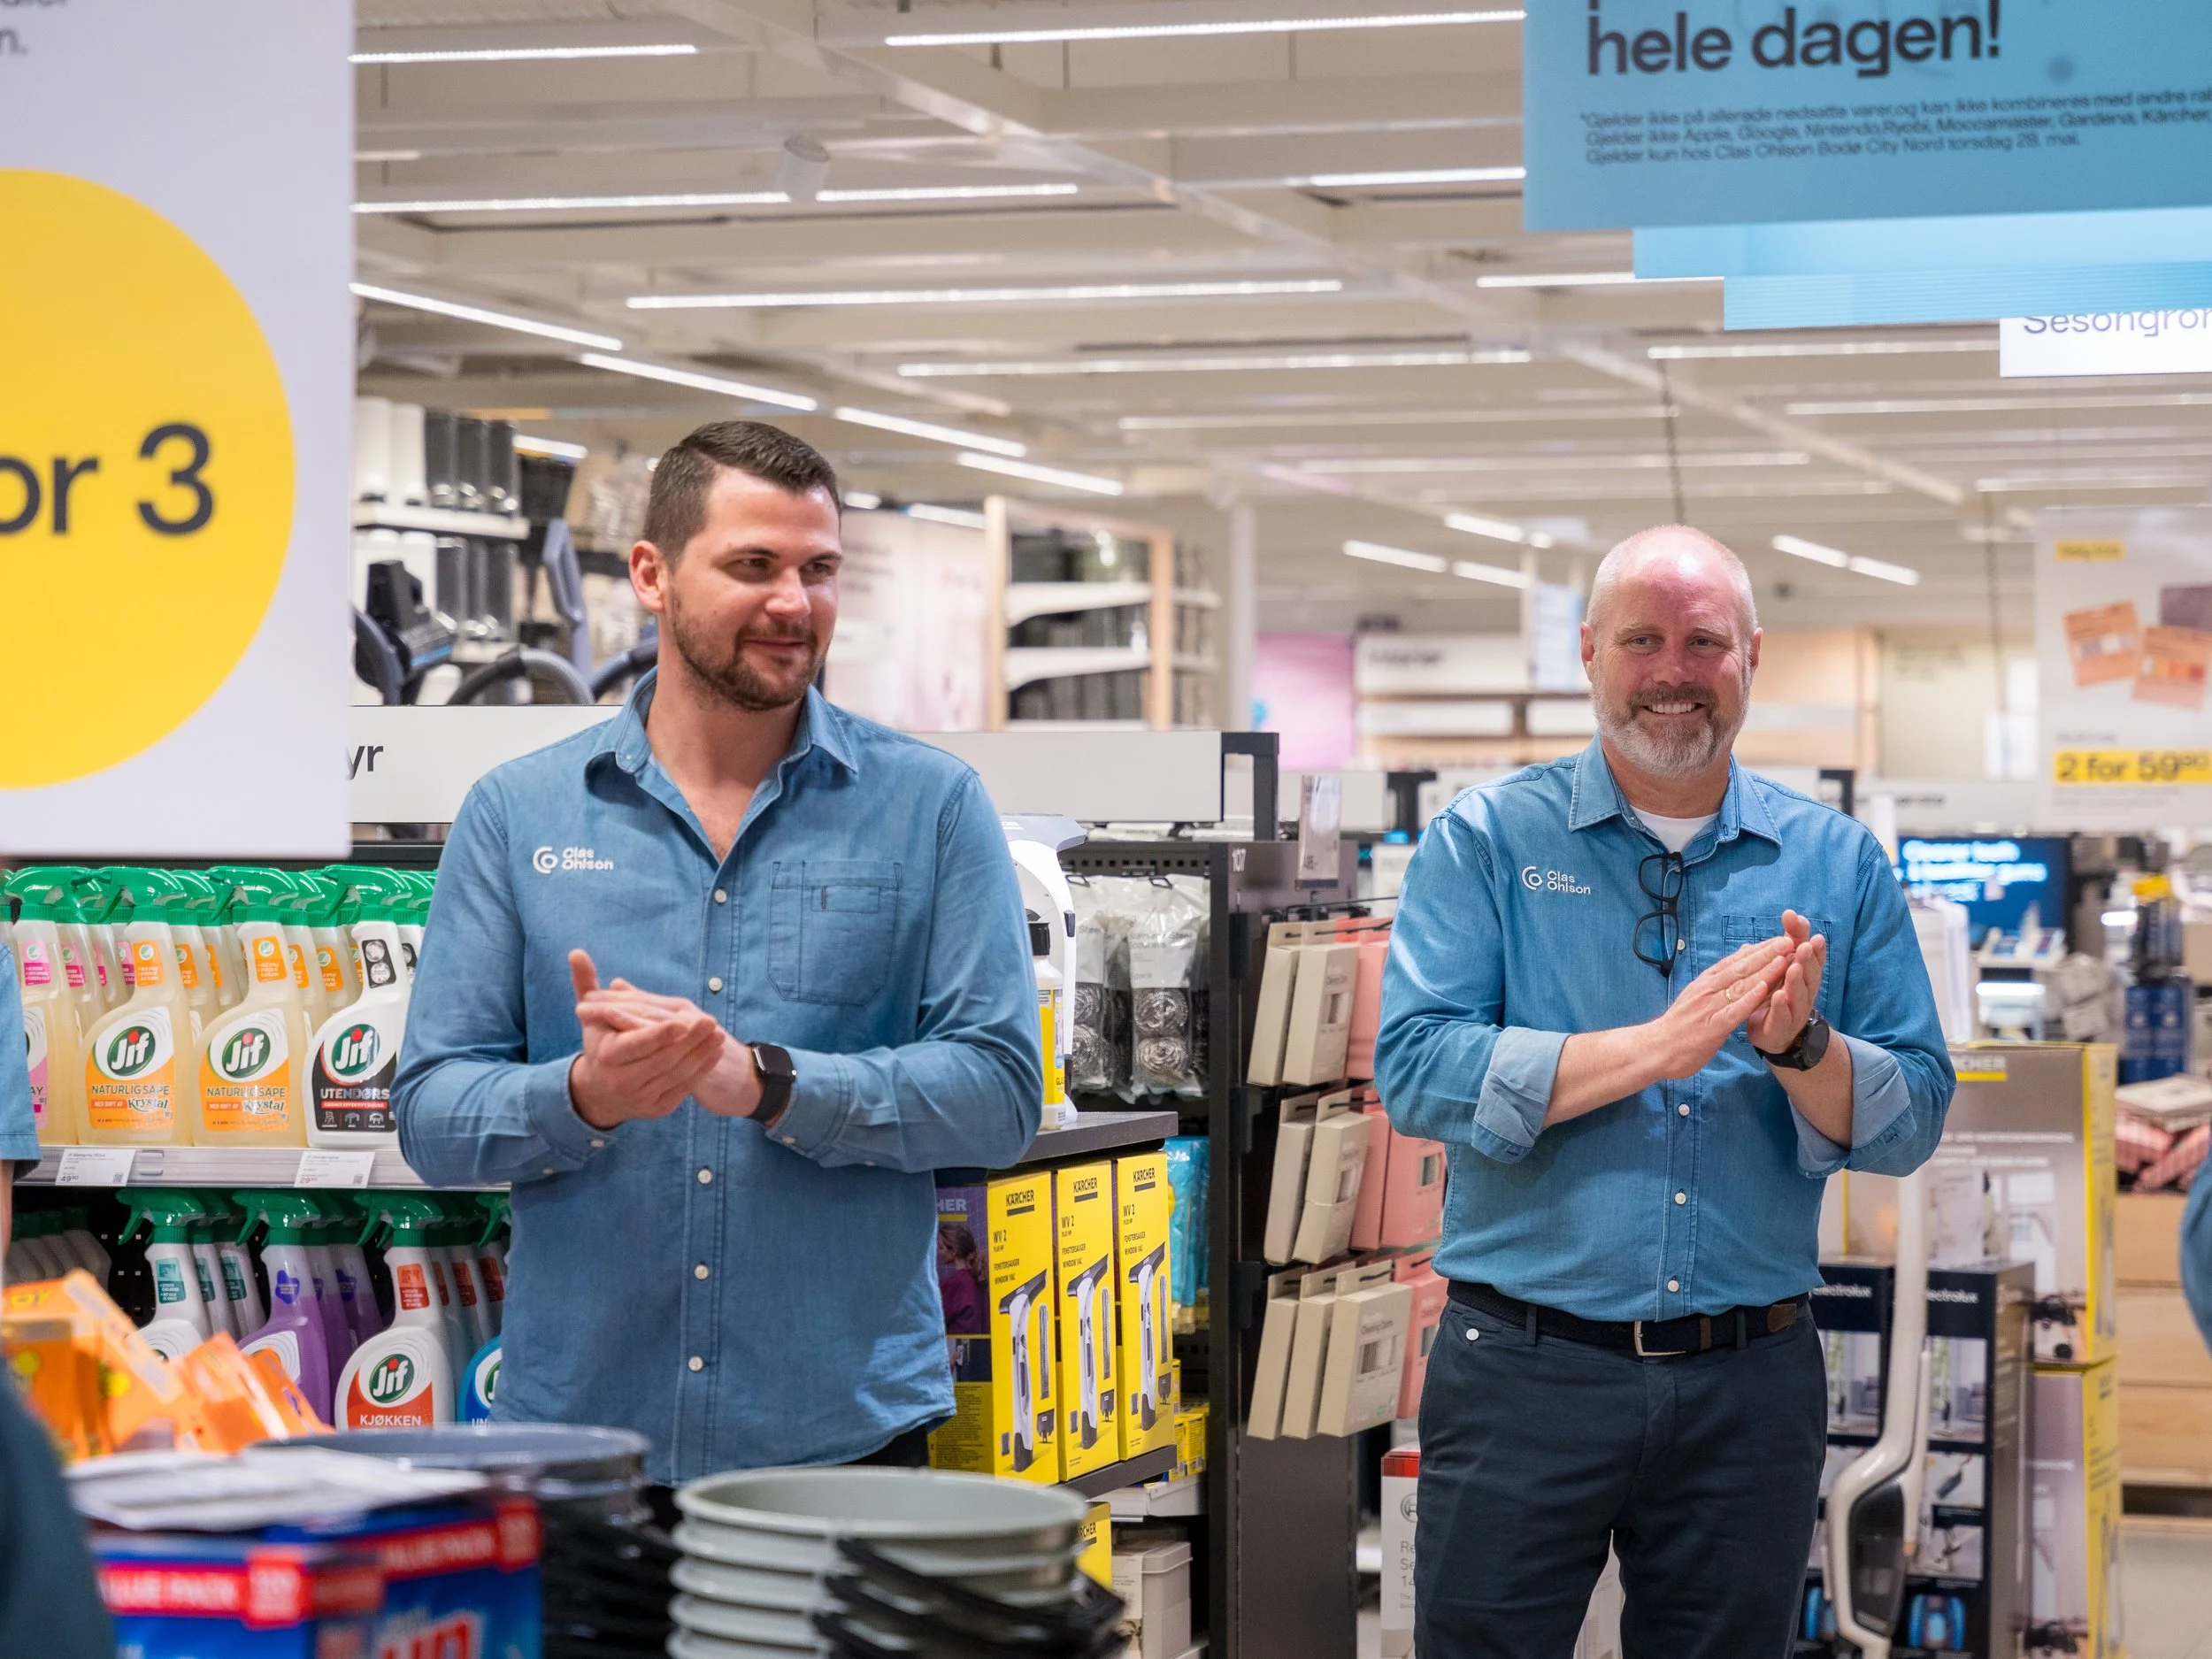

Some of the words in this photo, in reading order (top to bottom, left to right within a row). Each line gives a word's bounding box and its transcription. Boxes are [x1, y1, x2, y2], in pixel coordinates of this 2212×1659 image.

[1588, 12, 1732, 75] hele
[1751, 0, 2001, 78] dagen!
[1955, 96, 1988, 113] ikke
[1991, 94, 2091, 111] kombineres
[2093, 90, 2134, 107] med
[2136, 88, 2186, 105] andre
[1714, 142, 1752, 160] Clas
[1755, 141, 1814, 160] Ohlson
[1902, 135, 1945, 153] Nord
[135, 421, 215, 538] 3
[2058, 753, 2078, 781] 2
[2087, 753, 2127, 782] for
[562, 846, 595, 858] Clas
[562, 858, 614, 871] Ohlson
[1547, 871, 1576, 883] Clas
[1547, 880, 1592, 895] Ohlson
[111, 1030, 150, 1071] Jif
[226, 1032, 265, 1072] Jif
[334, 1027, 374, 1070] Jif
[92, 1085, 142, 1095] NATURLIG
[206, 1087, 257, 1097] NATURLIG
[127, 1097, 169, 1110] Krystal
[244, 1100, 285, 1113] Krystal
[1123, 1205, 1131, 1217] WV
[1062, 1216, 1071, 1229] WV
[993, 1230, 1002, 1243] WV
[373, 1357, 409, 1398] Jif
[360, 1414, 422, 1426] KJØKKEN
